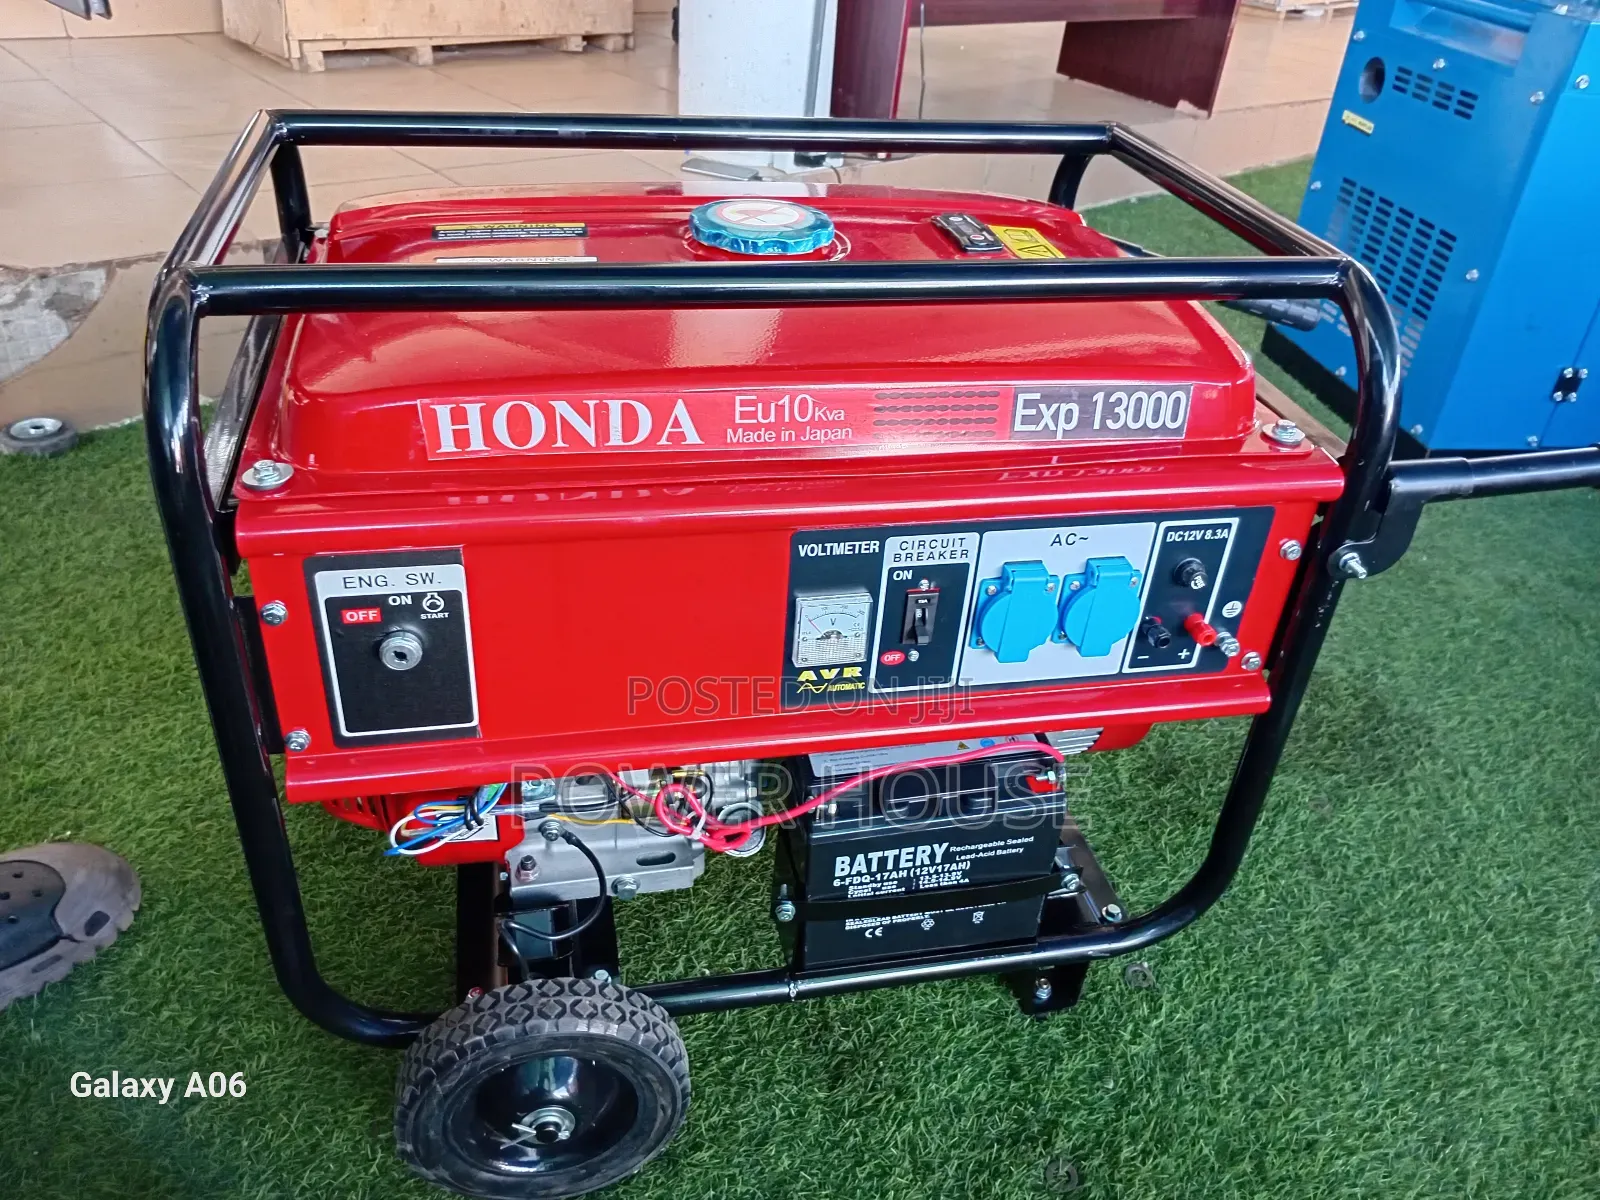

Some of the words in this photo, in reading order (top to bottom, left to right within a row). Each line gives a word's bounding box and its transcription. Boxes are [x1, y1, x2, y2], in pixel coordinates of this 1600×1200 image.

[1013, 392, 1079, 439] Exp
[1090, 390, 1187, 431] 13000
[430, 398, 705, 453] HONDA
[726, 427, 776, 443] Made
[781, 427, 796, 442] in
[800, 426, 853, 444] Japan
[1166, 529, 1204, 543] DC12V
[1205, 528, 1229, 541] 8.3A
[798, 540, 880, 557] VOLTMETER
[899, 537, 966, 551] CIRCUIT
[893, 549, 969, 563] BREAKER
[343, 574, 396, 589] ENG.
[405, 572, 442, 586] SW.
[893, 569, 913, 581] ON
[388, 595, 413, 606] ON
[345, 610, 378, 622] OFF
[420, 612, 449, 620] START
[830, 617, 837, 626] V
[884, 653, 901, 662] OFF
[797, 666, 863, 682] AVR
[827, 682, 866, 692] AUTOMATIC
[950, 841, 1005, 853] Rechargeable
[1006, 836, 1034, 845] Sealed
[834, 842, 949, 877] BATTERY
[956, 850, 995, 861] Lead-Acid
[996, 847, 1024, 856] Battery
[833, 869, 908, 887] 6-FDQ-17AH
[910, 860, 971, 878] (12V17AH)
